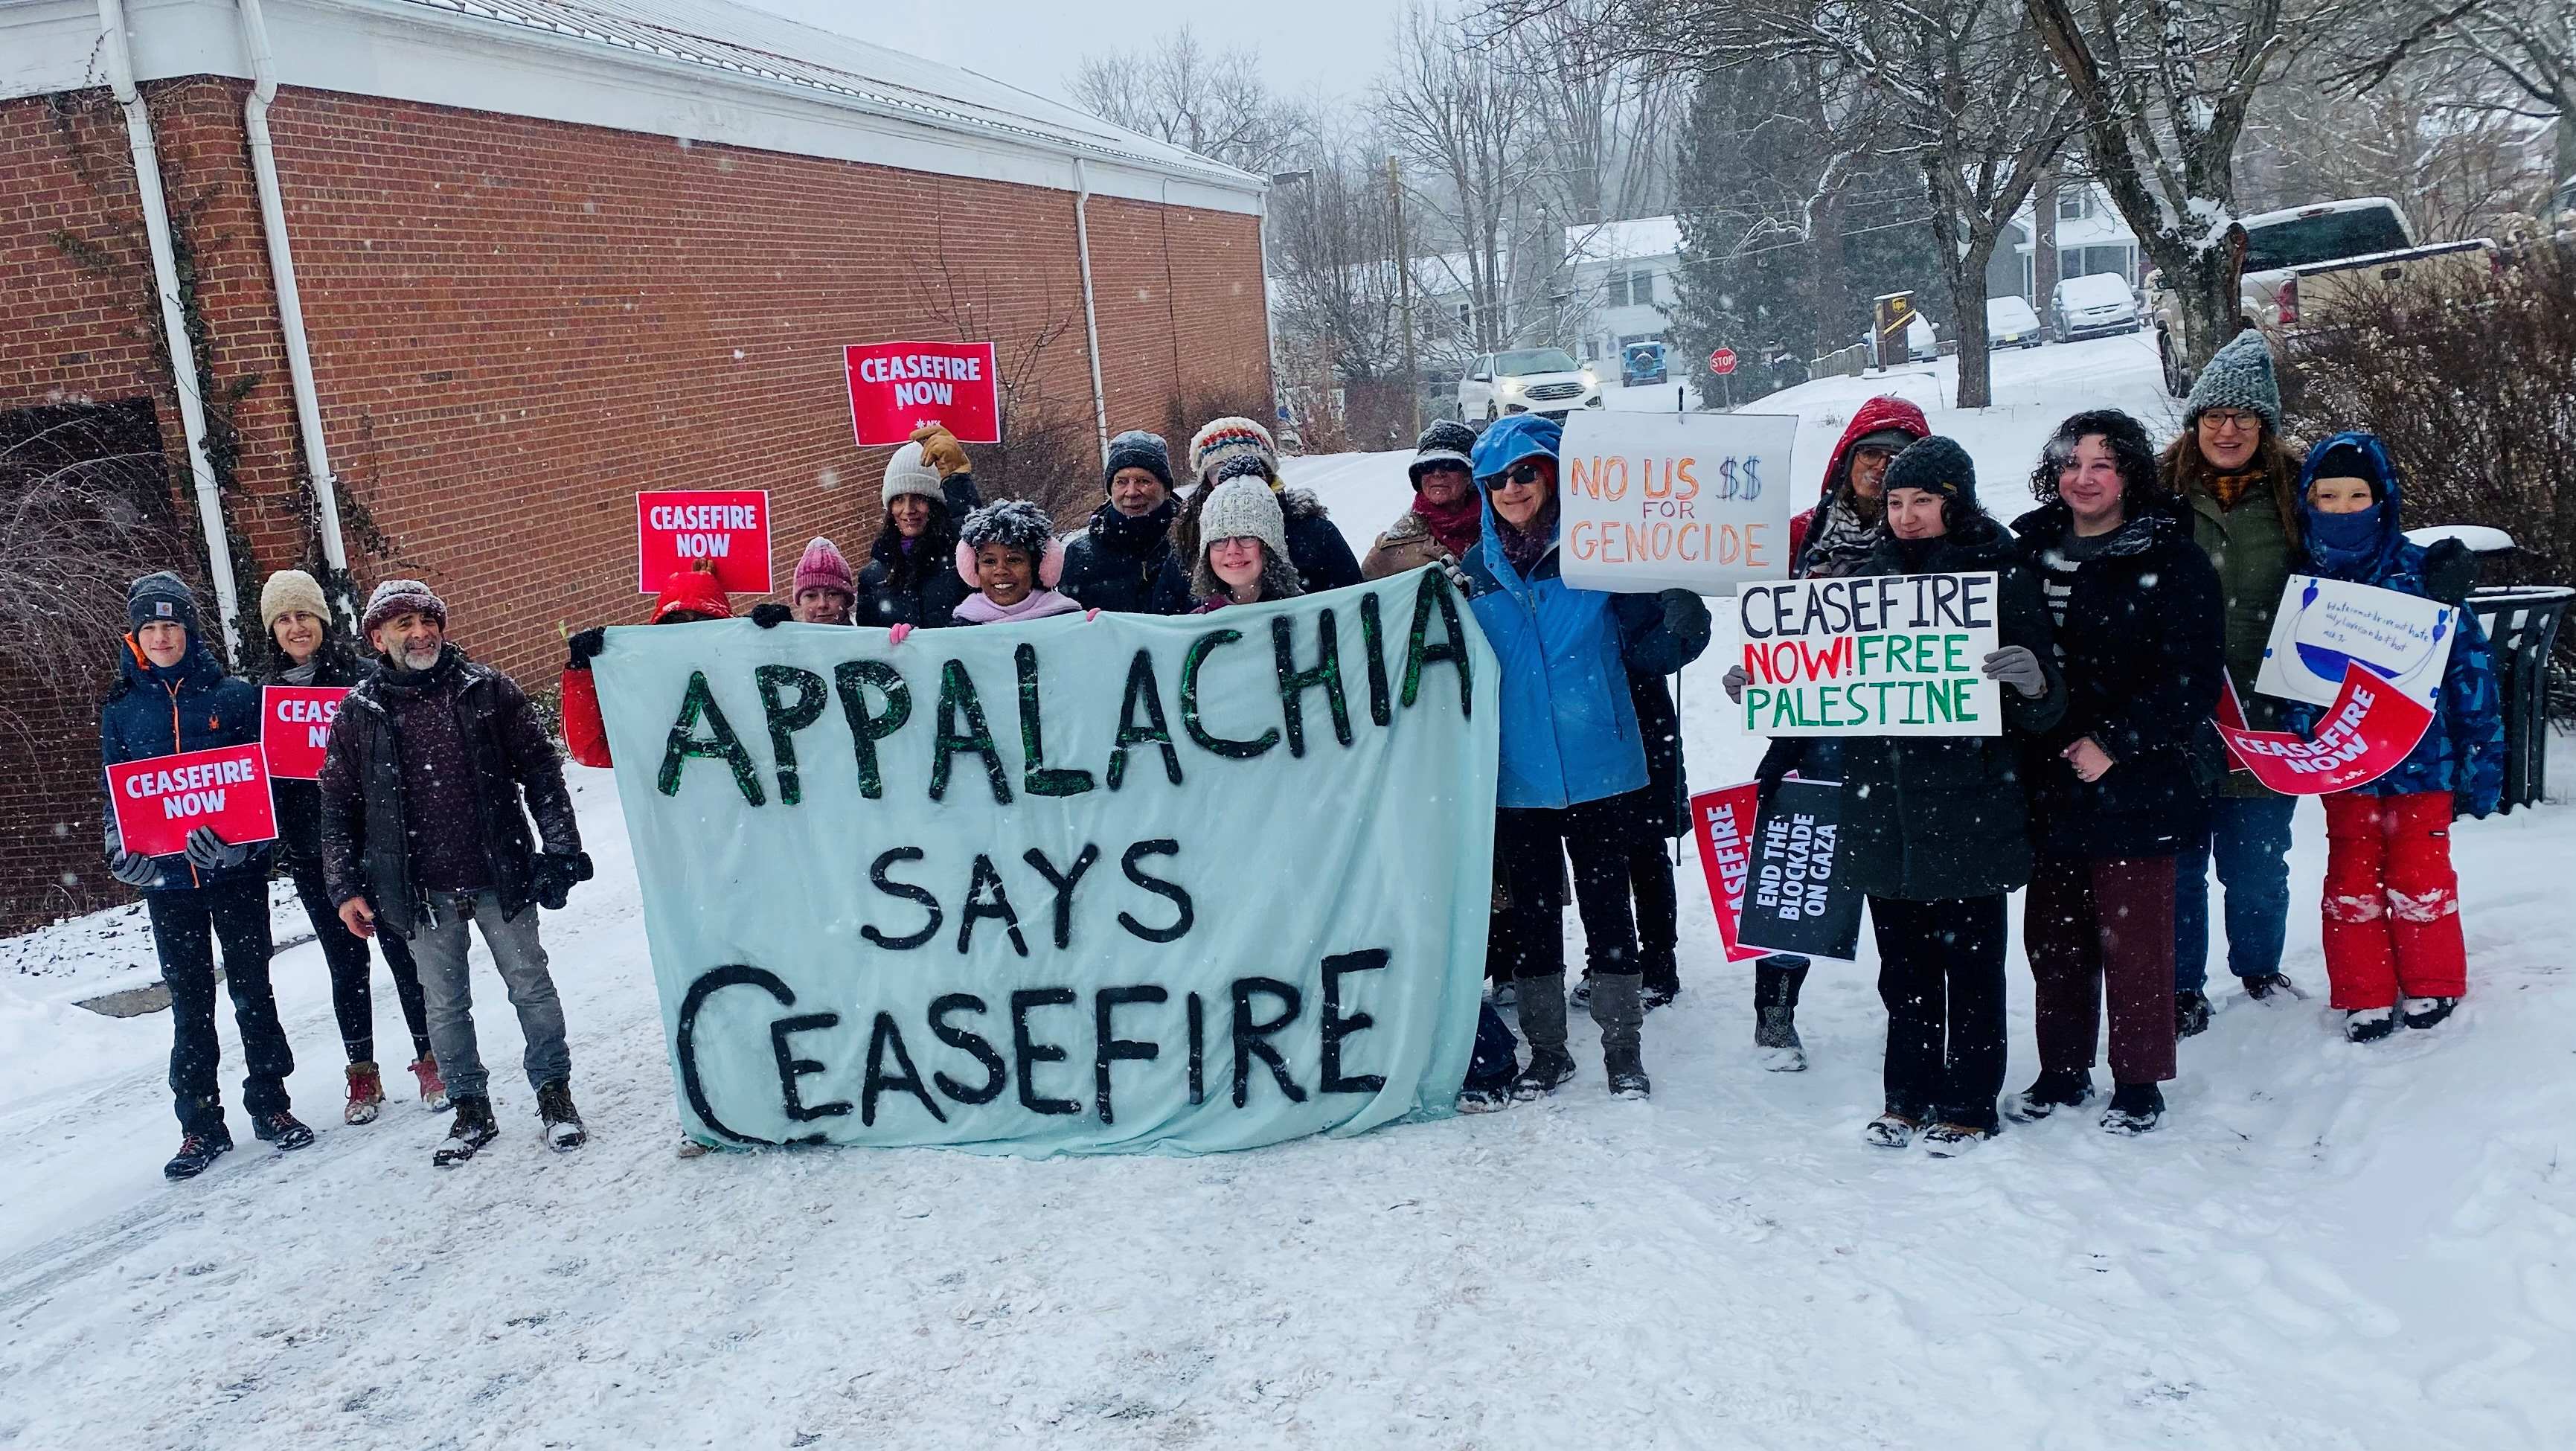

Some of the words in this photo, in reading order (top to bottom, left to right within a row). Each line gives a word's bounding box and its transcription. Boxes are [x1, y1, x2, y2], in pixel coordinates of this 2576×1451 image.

[860, 354, 981, 382] CEASEFIRE
[1712, 354, 1734, 368] STOP
[894, 381, 953, 407] NOW
[1571, 455, 1629, 502] NO
[1644, 458, 1699, 501] US
[1715, 455, 1763, 502] $$
[650, 505, 757, 531] CEASEFIRE
[1642, 501, 1695, 519] FOR
[676, 534, 731, 558] NOW
[1571, 521, 1769, 566] GENOCIDE
[1741, 574, 1992, 638] CEASEFIRE
[2408, 624, 2429, 642] hate
[1744, 635, 1853, 685] NOW!
[1858, 634, 1970, 675] FREE
[657, 566, 1473, 807] APPALACHIA
[1747, 678, 1979, 730] PALESTINE
[2234, 684, 2376, 758] CEASEFIRE
[2284, 733, 2369, 774] NOW
[125, 757, 255, 798] CEASEFIRE
[162, 789, 225, 819] NOW
[1763, 820, 1790, 860] THE
[1810, 824, 1838, 880] GAZA
[1756, 864, 1781, 907] END
[1778, 813, 1815, 921] BLOCKADE
[859, 837, 1194, 958] SAYS
[1804, 884, 1828, 917] ON
[676, 947, 1391, 1145] CEASEFIRE
